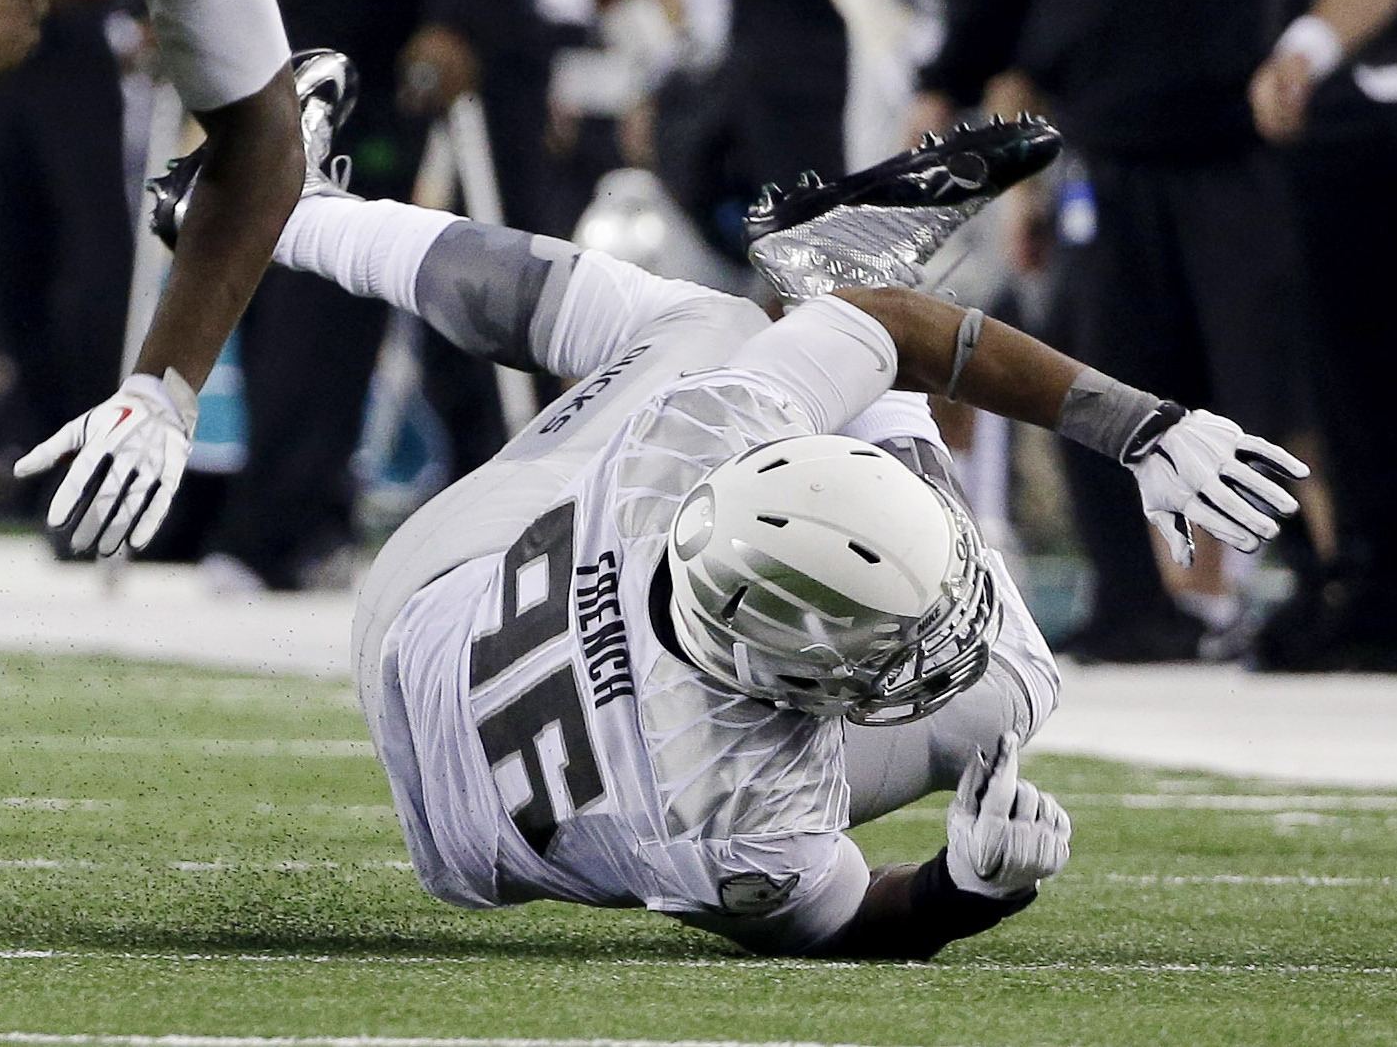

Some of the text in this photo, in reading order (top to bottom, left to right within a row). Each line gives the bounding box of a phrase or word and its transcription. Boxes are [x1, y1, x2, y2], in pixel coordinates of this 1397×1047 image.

[539, 344, 652, 434] DUCKS
[468, 500, 606, 858] 96
[576, 550, 634, 709] FRENCH
